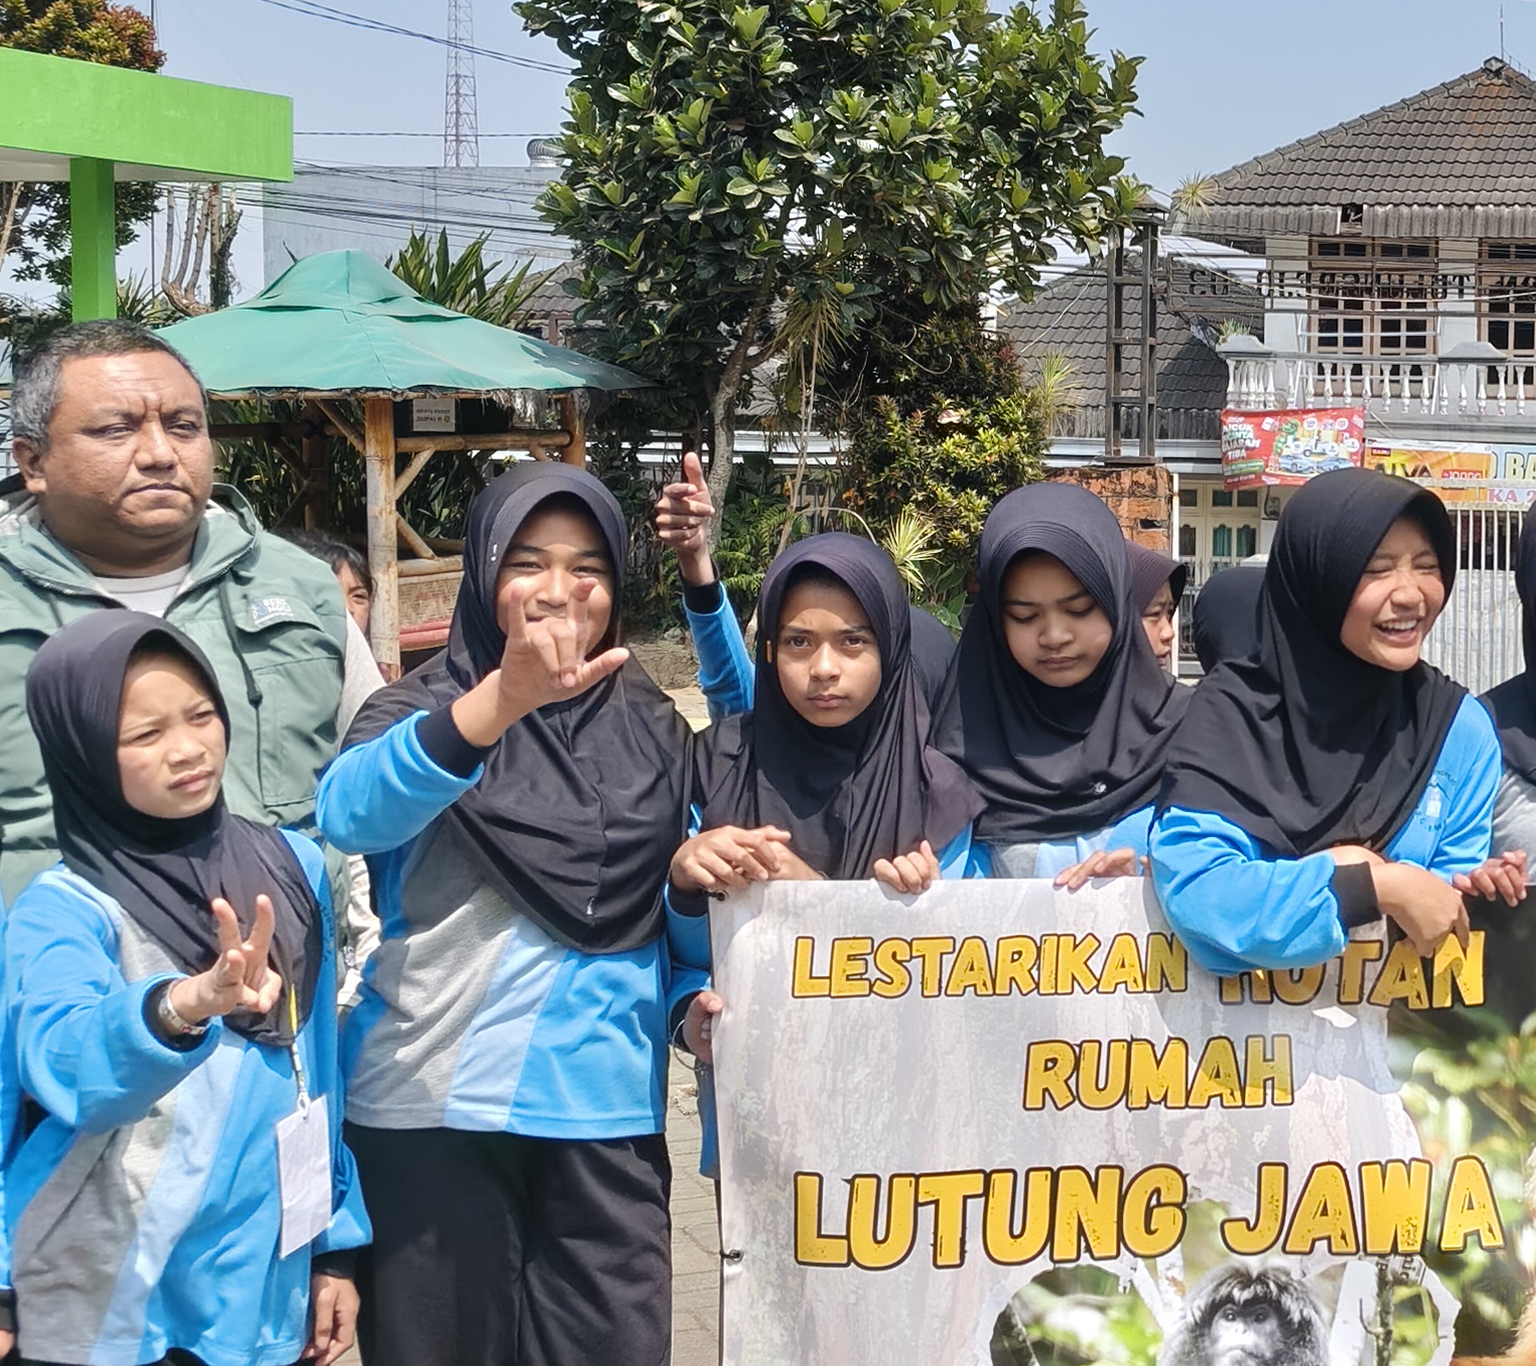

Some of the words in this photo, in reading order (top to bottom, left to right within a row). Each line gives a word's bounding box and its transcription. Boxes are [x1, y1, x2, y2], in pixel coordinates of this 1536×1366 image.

[791, 931, 1188, 999] LESTARIKAN
[1022, 1034, 1293, 1111] RUMAH
[793, 1163, 1188, 1271] LUTUNG
[1222, 1155, 1506, 1257] JAWA
